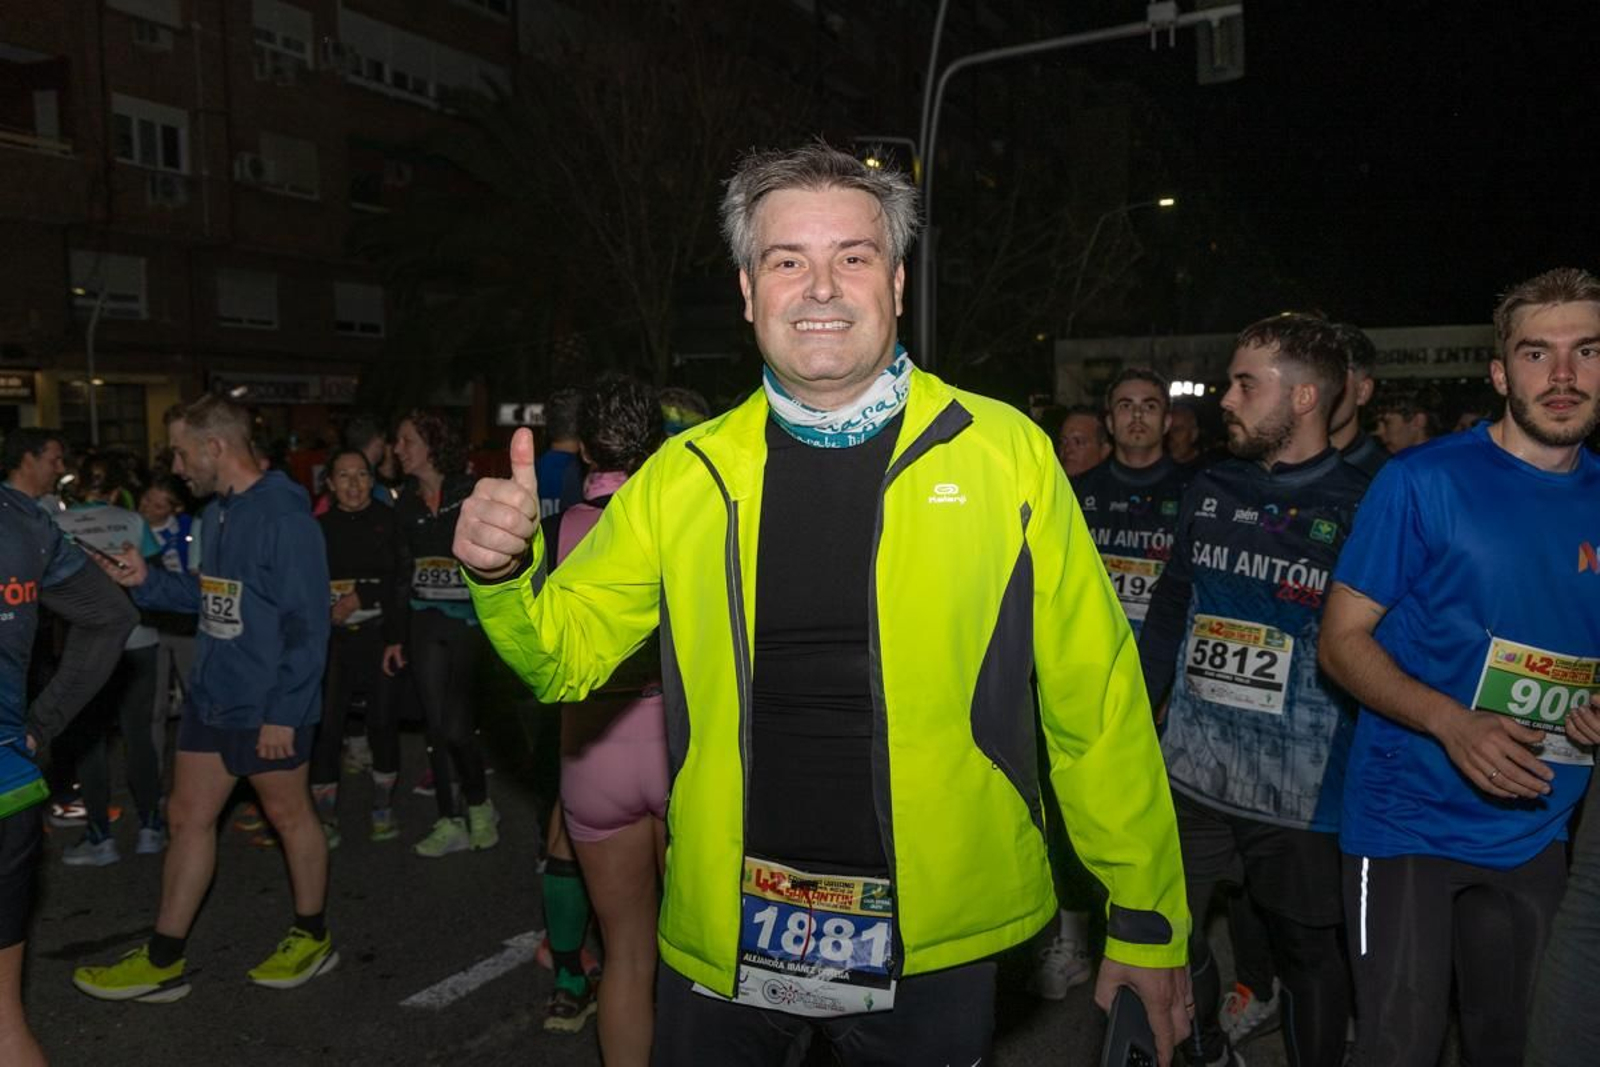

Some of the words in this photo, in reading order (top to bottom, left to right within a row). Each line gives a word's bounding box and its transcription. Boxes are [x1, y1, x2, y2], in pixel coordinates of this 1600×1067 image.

[1090, 527, 1112, 546] AN
[1191, 540, 1229, 571] SAN
[1233, 551, 1330, 591] ANTÓN
[1275, 576, 1323, 609] 2025
[1192, 638, 1280, 680] 5812
[1524, 653, 1555, 677] 42
[754, 867, 788, 897] 42
[753, 905, 890, 968] 1881
